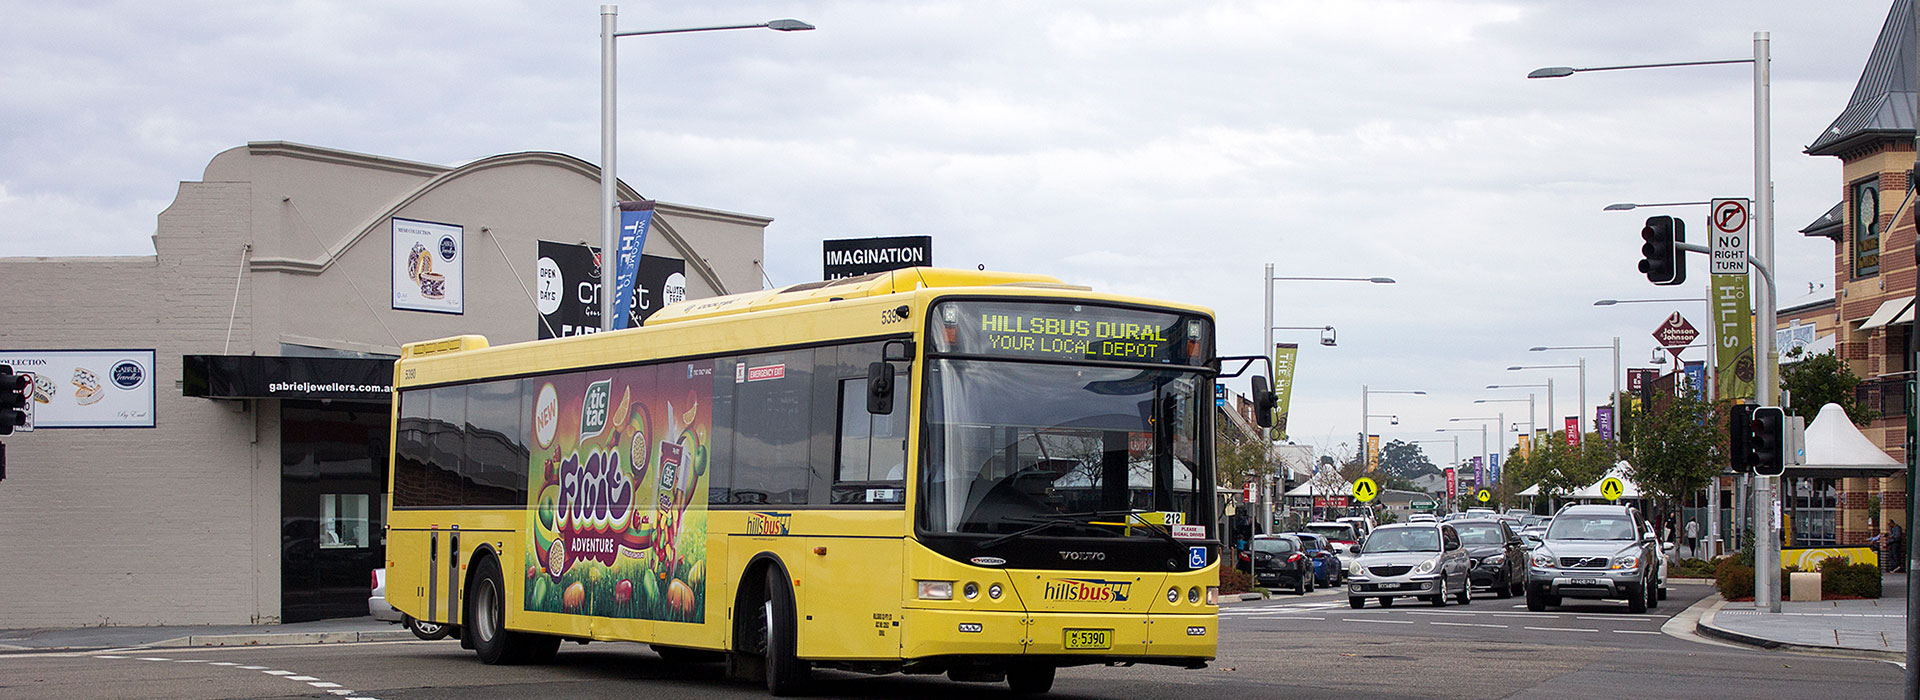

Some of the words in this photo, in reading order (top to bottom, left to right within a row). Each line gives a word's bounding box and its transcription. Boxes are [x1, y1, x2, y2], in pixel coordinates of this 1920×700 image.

[620, 220, 639, 266] THE
[1719, 236, 1741, 248] NO
[826, 246, 923, 266] IMAGINATION
[1715, 250, 1744, 259] RIGHT
[540, 267, 556, 278] OPEN
[1716, 261, 1744, 270] TURN
[546, 280, 551, 291] 7
[540, 290, 556, 301] DAYS
[1719, 286, 1739, 349] HILLS
[982, 314, 1090, 337] HILLSBUS
[1096, 321, 1167, 342] DURAL
[989, 334, 1035, 351] YOUR
[1041, 337, 1097, 355] LOCAL
[1103, 341, 1158, 358] DEPOT
[750, 367, 774, 378] EMERGENCY
[774, 366, 784, 374] EXIT
[1278, 353, 1289, 376] THE
[591, 387, 606, 409] tic
[537, 399, 556, 433] NEW
[586, 406, 605, 427] tac
[746, 515, 780, 535] hillsbus
[1165, 513, 1181, 524] 212
[571, 537, 614, 553] ADVENTURE
[1059, 551, 1106, 561] VOLVO
[1044, 581, 1111, 601] hillsbus
[1081, 632, 1105, 645] 5390
